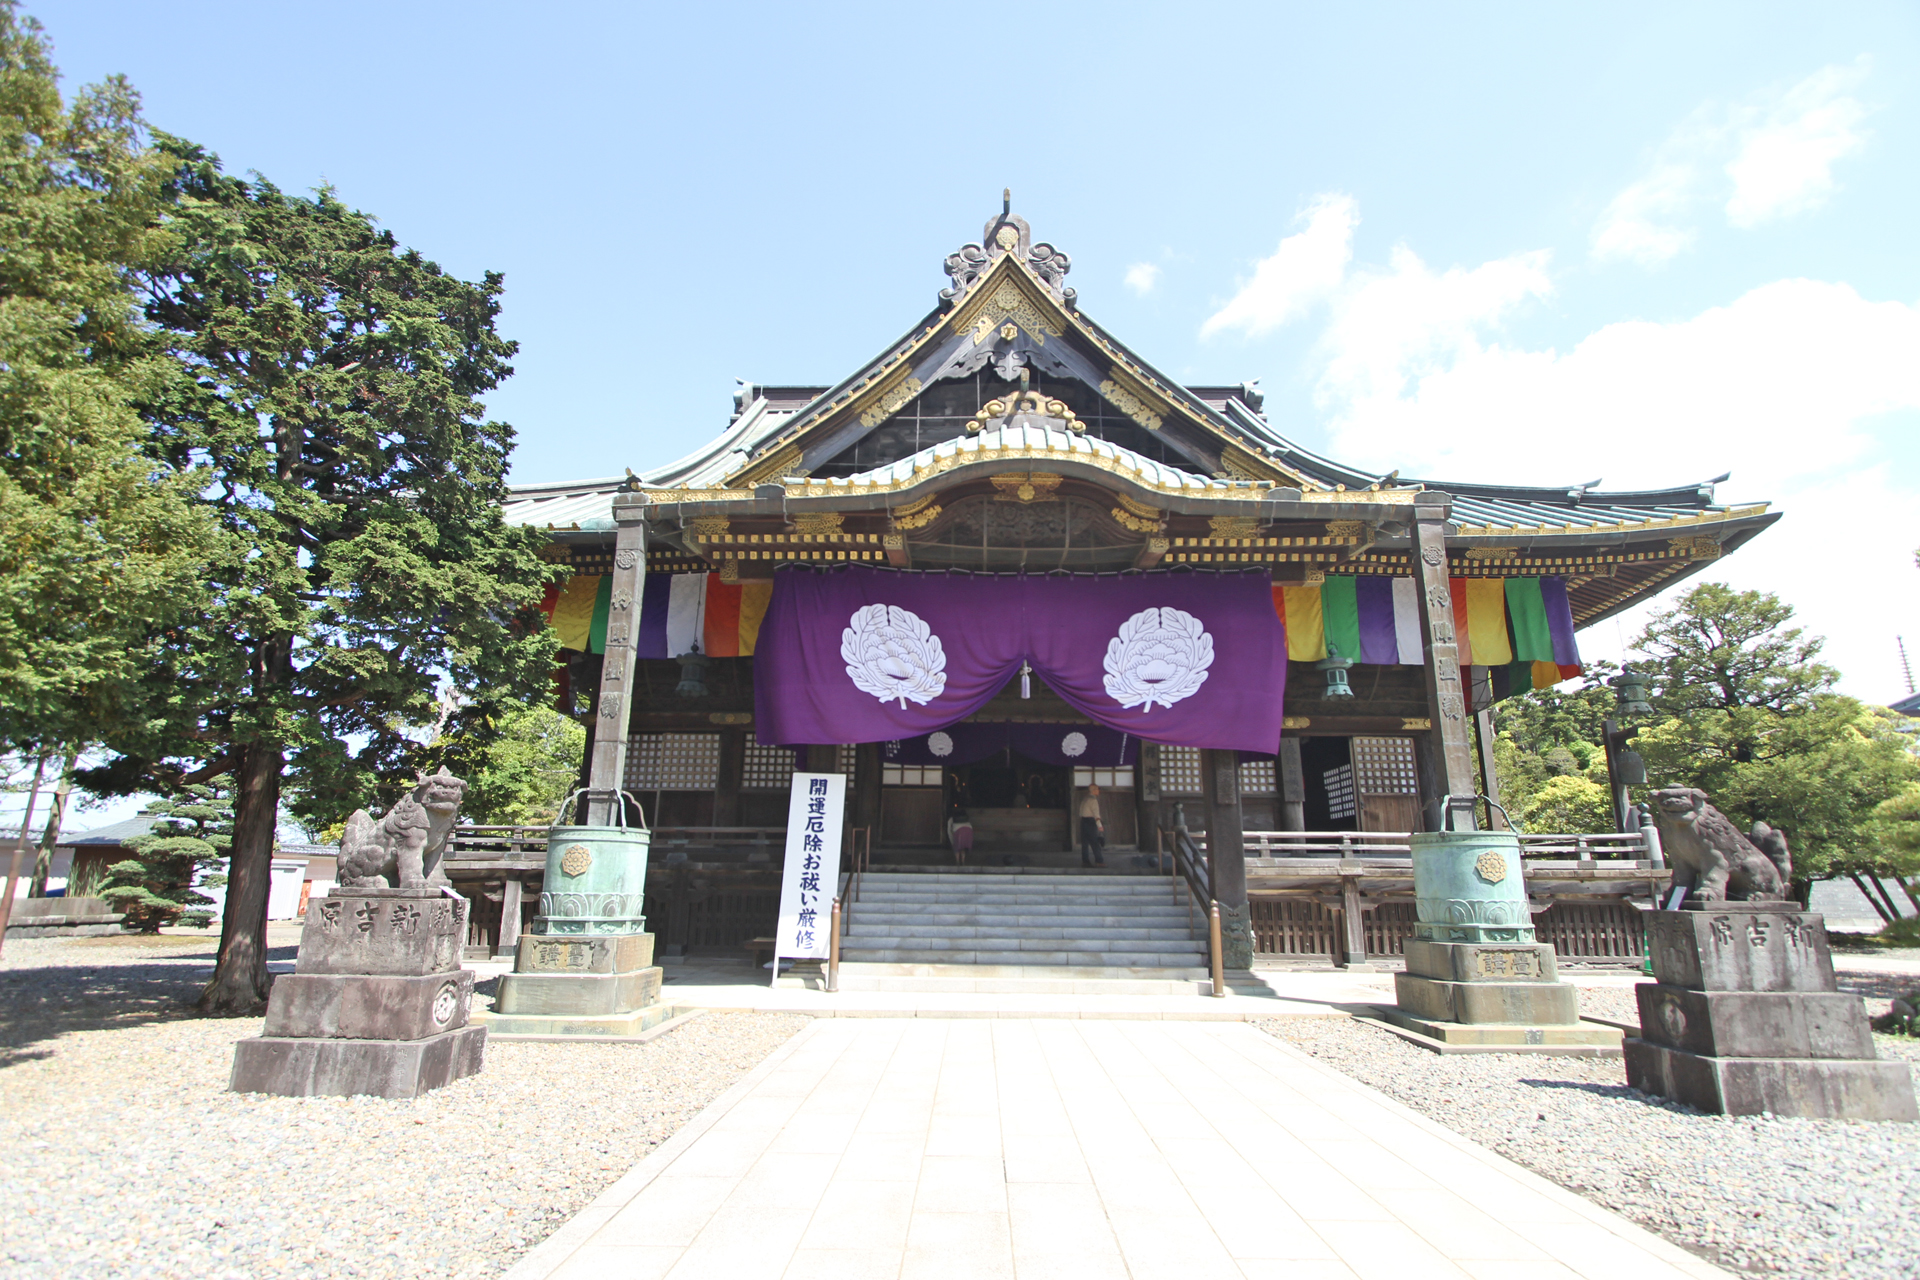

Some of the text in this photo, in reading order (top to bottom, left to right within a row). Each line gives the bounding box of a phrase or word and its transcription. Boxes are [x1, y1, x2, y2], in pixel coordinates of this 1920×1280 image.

[796, 778, 828, 950] 開運厄除お祓い厳修
